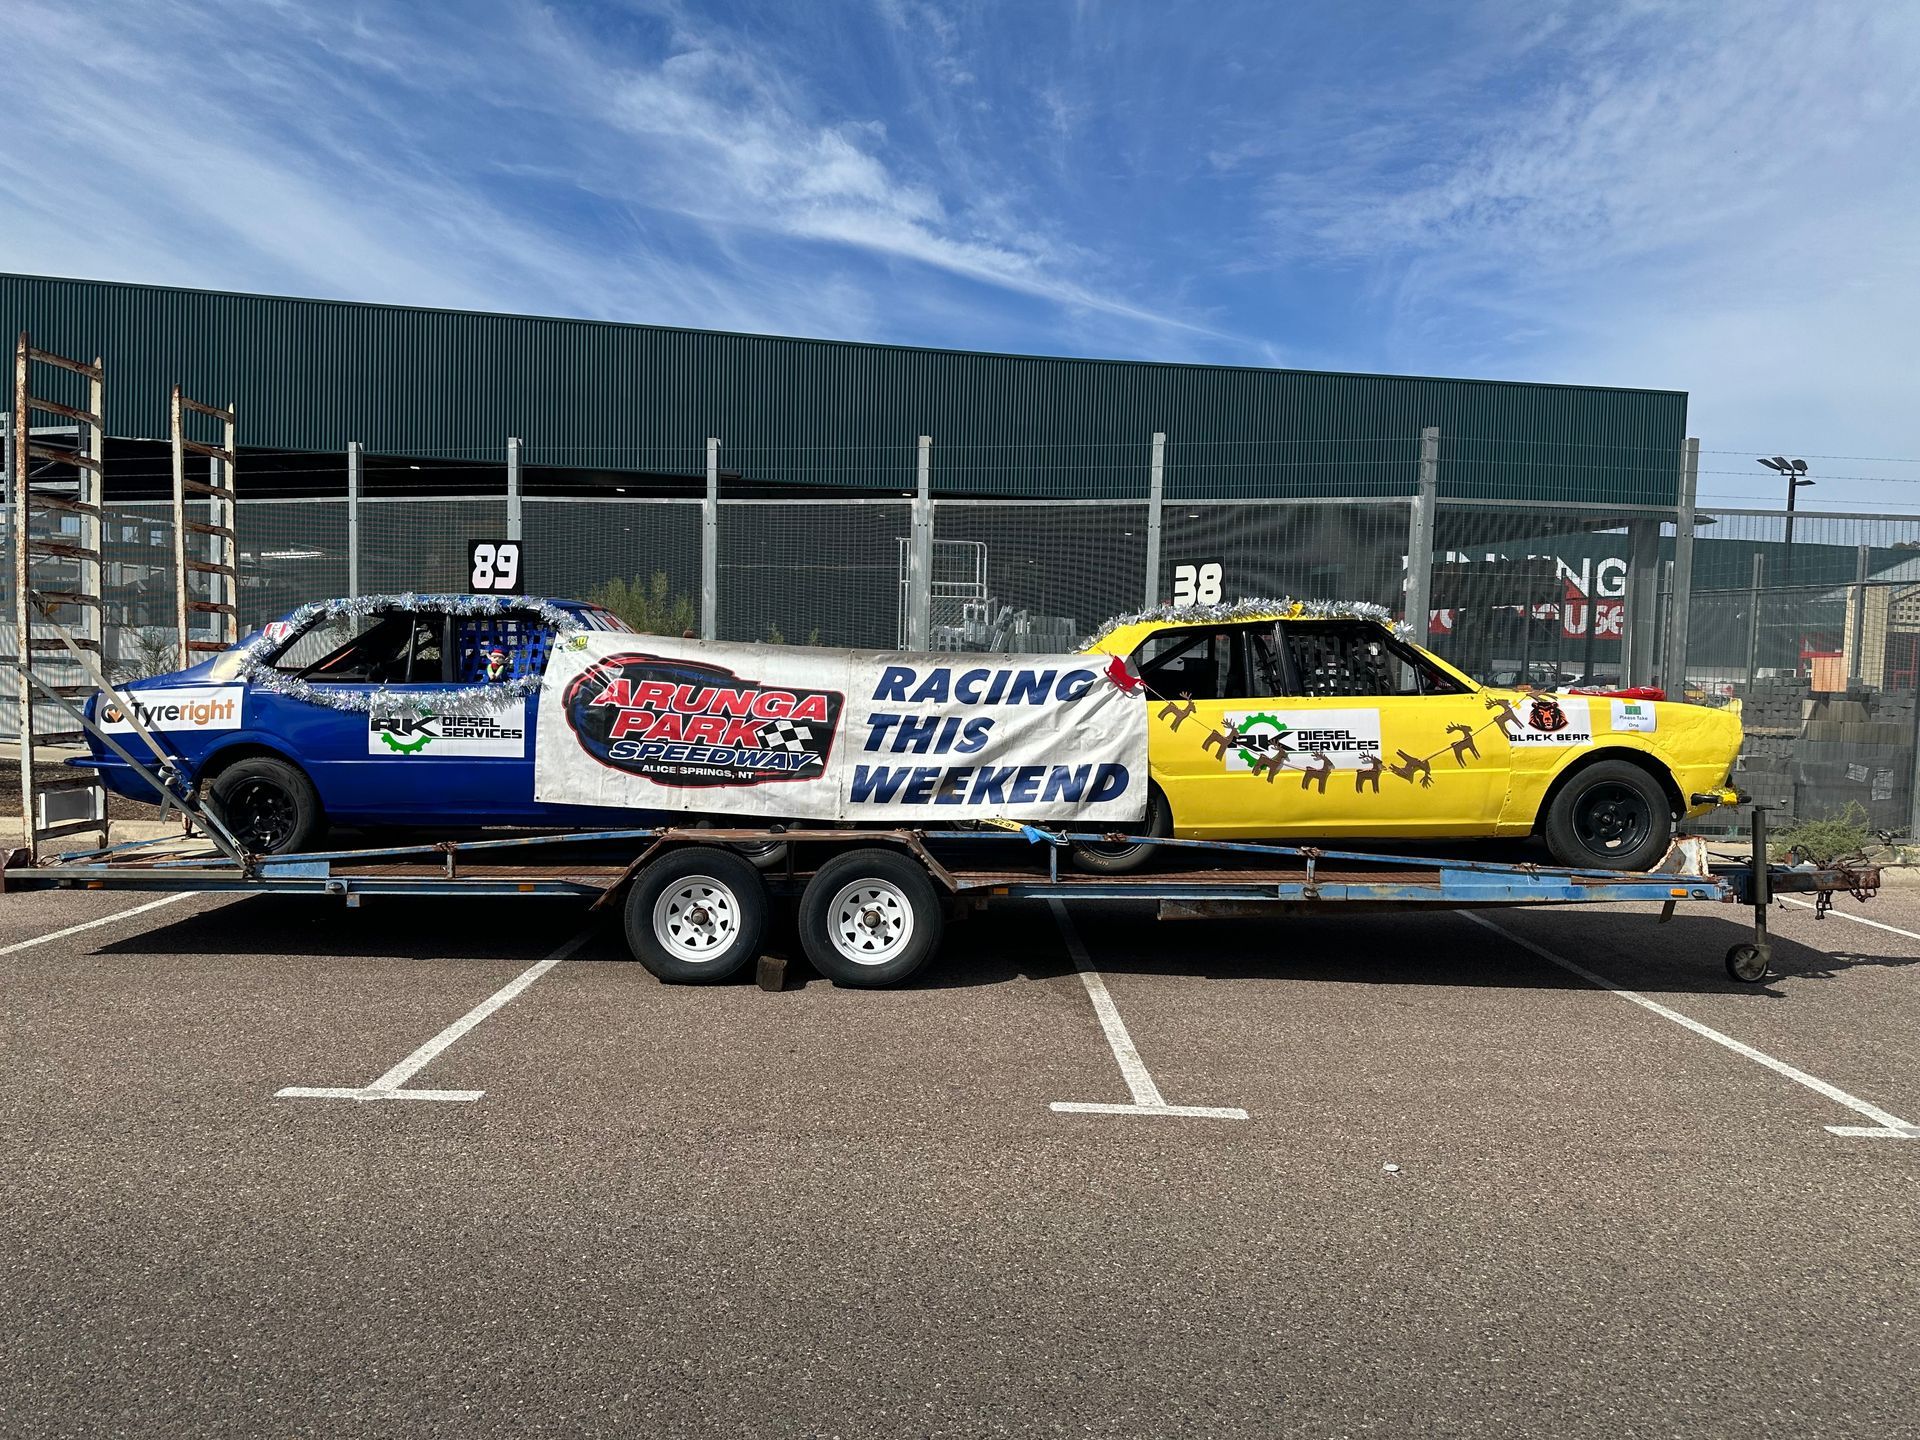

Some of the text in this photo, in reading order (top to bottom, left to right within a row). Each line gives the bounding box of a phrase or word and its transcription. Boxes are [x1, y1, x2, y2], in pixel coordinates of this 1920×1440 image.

[471, 544, 519, 589] 89
[1174, 563, 1222, 608] 38
[589, 679, 828, 723] ARUNGA
[872, 666, 1097, 706] RACING
[131, 699, 234, 727] Tyreright
[442, 716, 500, 728] DIESEL
[442, 728, 523, 739] SERVICES
[608, 709, 777, 748] PARK
[863, 713, 996, 754] THIS
[1297, 730, 1356, 741] DIESEL
[1509, 733, 1591, 742] BLACK BEAR
[609, 740, 816, 770] SPEEDWAY
[1298, 740, 1379, 752] SERVICES
[642, 764, 754, 779] ALICE SPRINGS, NT
[849, 763, 1130, 805] WEEKEND
